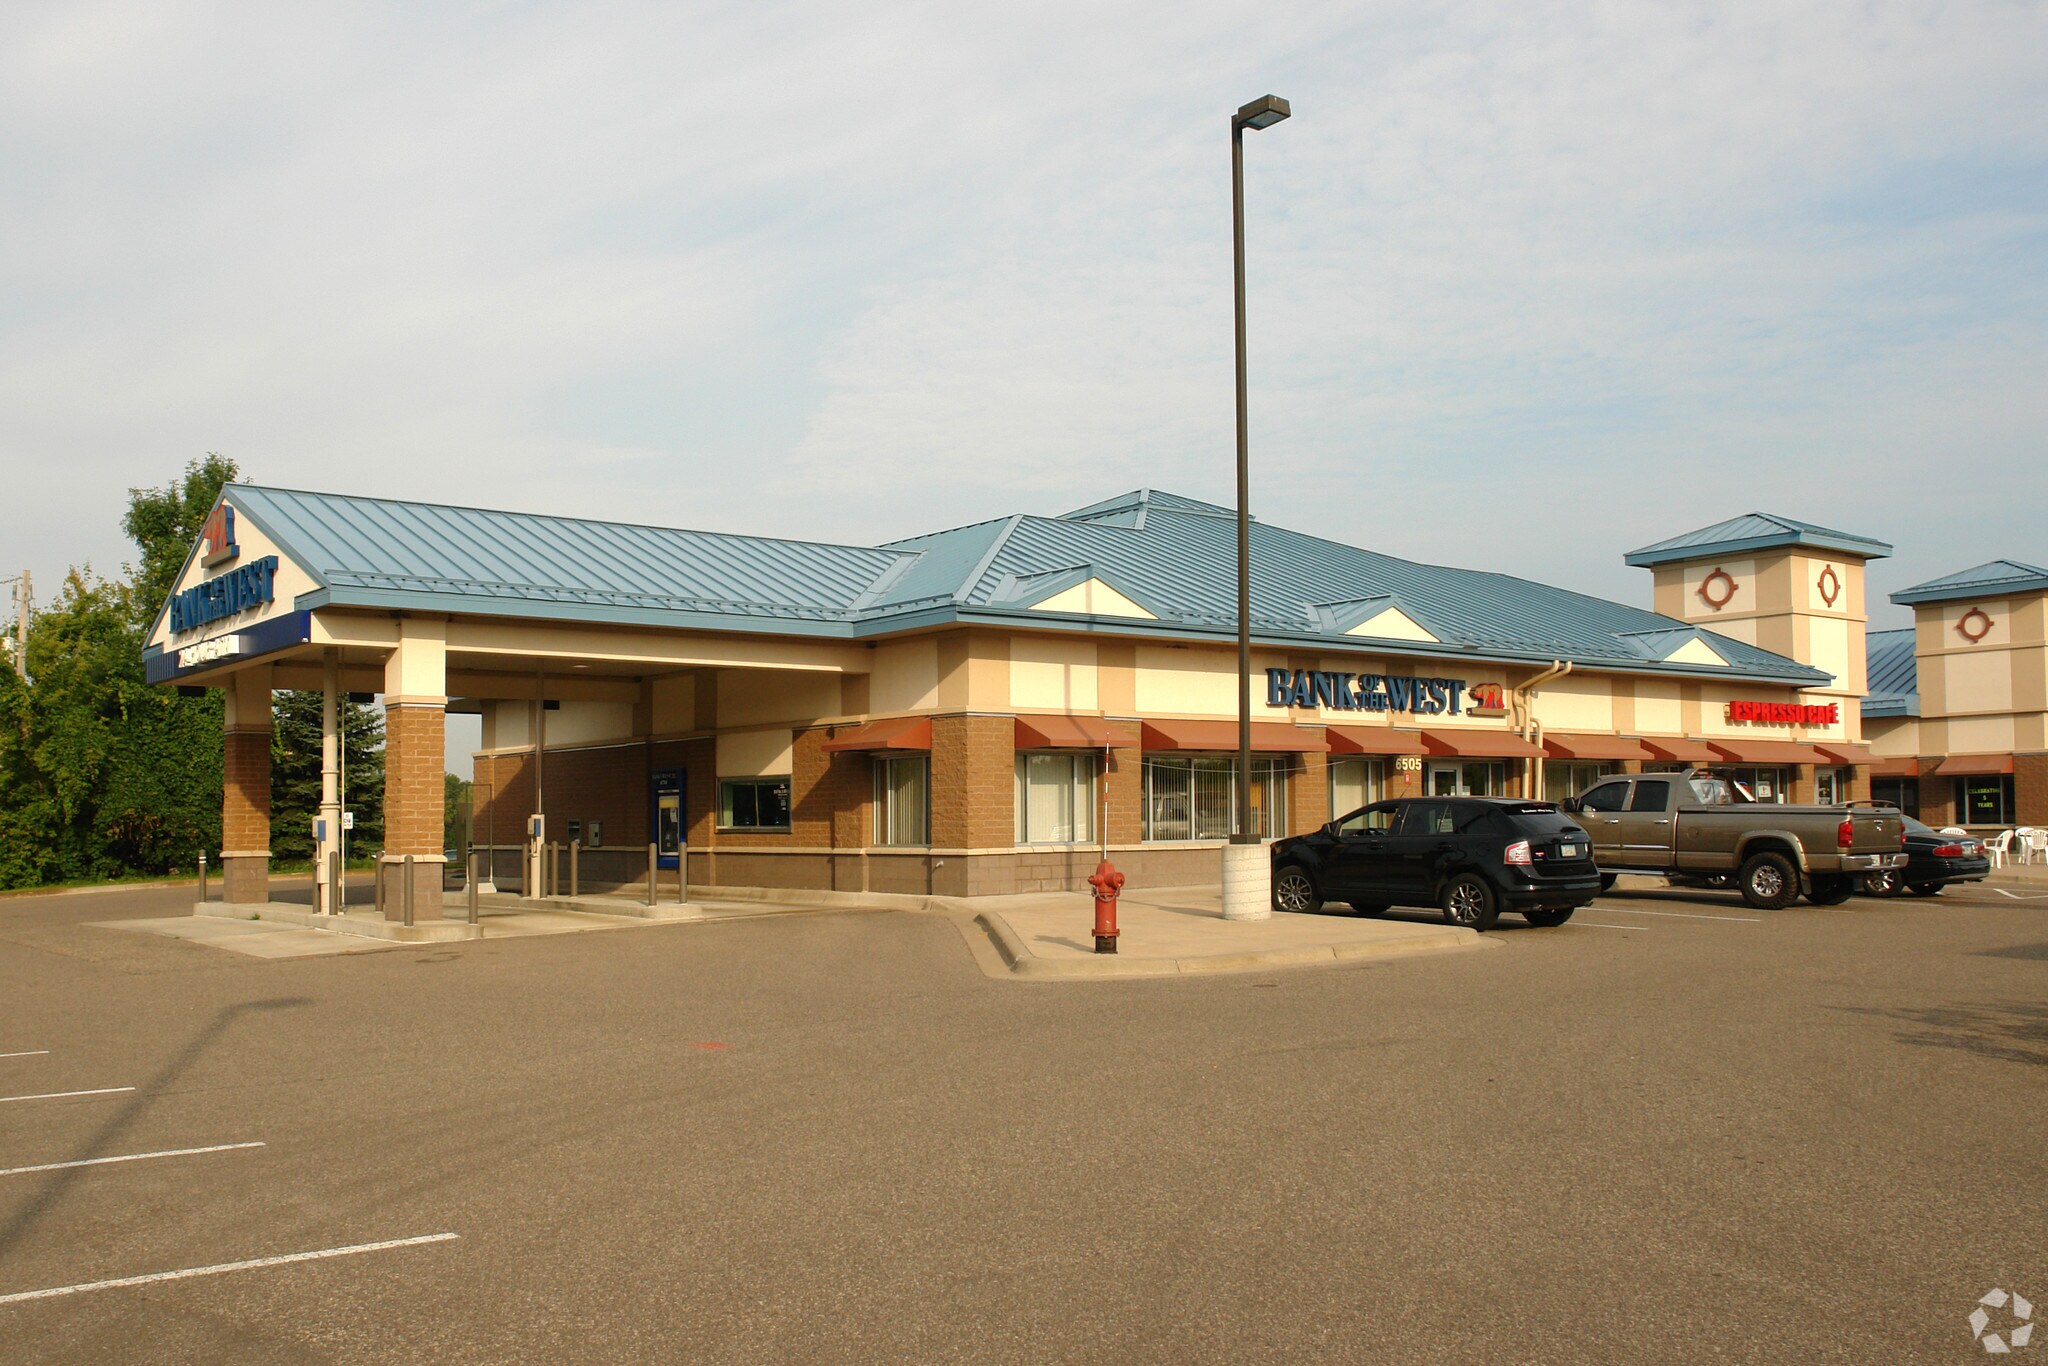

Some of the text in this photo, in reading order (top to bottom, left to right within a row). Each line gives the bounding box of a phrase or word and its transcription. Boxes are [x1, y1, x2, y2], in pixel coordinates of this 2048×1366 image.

[170, 580, 211, 634] BANK
[1266, 667, 1466, 714] BANK OF THE WEST
[1730, 701, 1839, 724] ESPRESSO CAFÉ
[1395, 757, 1422, 771] 6505
